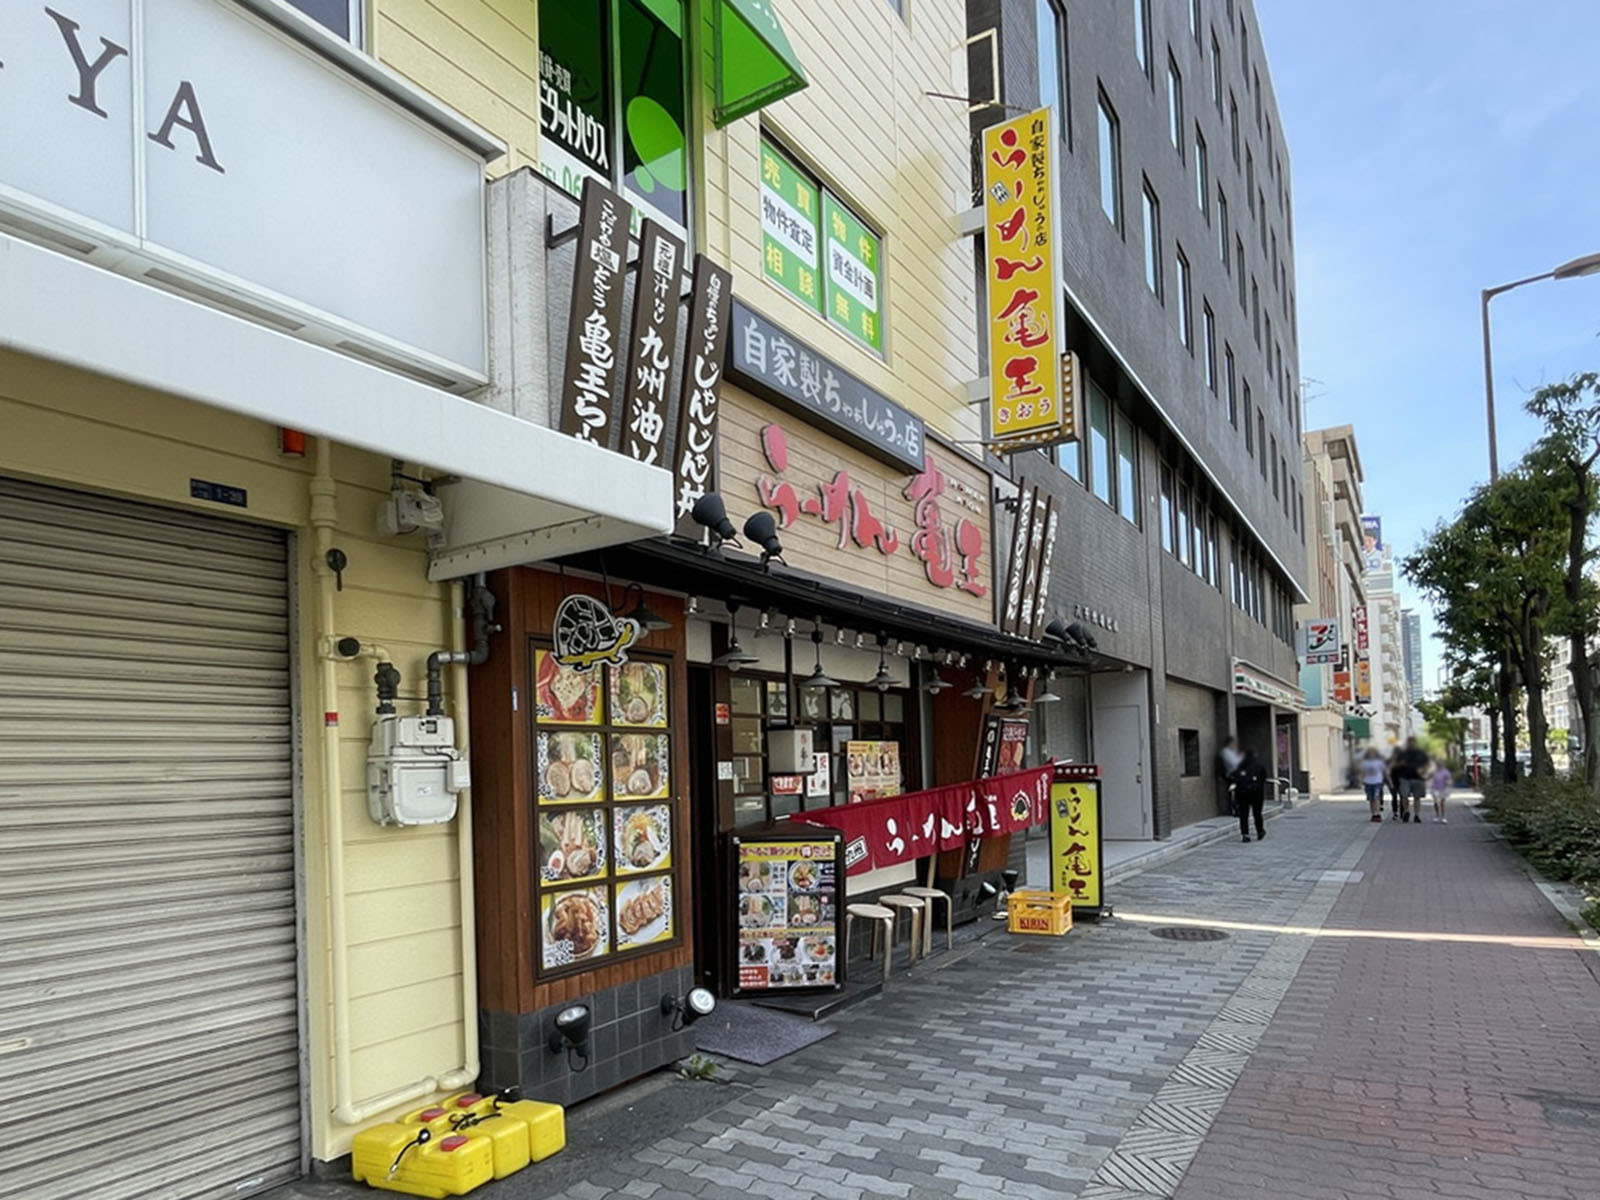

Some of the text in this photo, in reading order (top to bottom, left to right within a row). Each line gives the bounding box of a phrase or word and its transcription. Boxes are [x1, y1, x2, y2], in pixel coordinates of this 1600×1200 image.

[0, 6, 226, 174] YA
[763, 199, 875, 301] 物件査定 資金計画
[999, 399, 1051, 423] きおう
[1020, 918, 1049, 930] KIRIN
